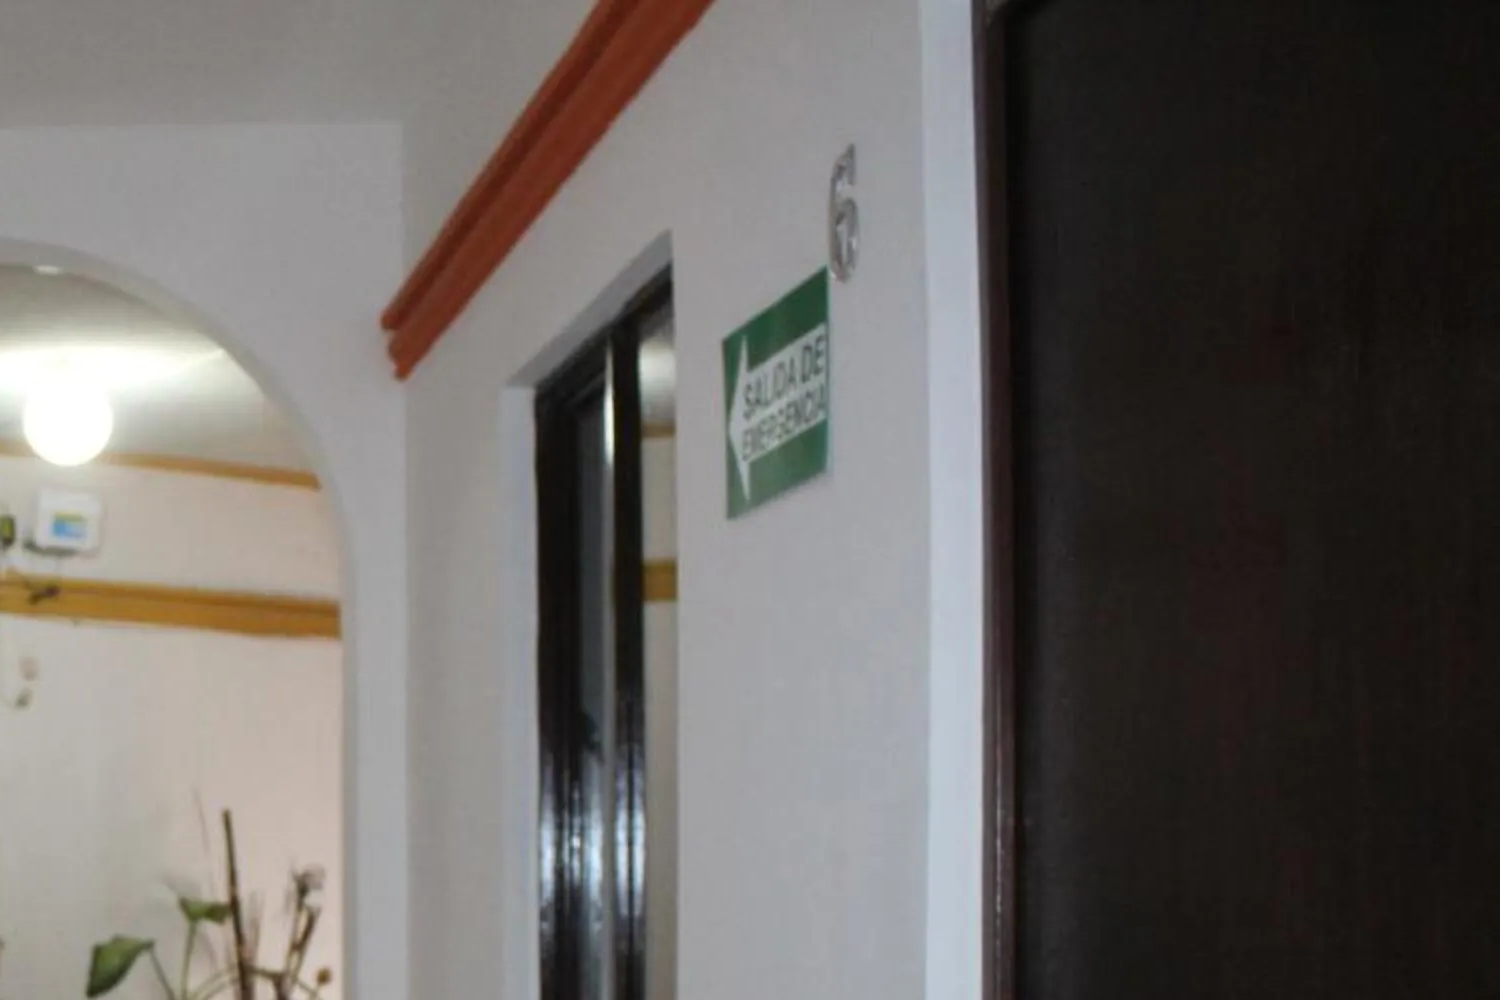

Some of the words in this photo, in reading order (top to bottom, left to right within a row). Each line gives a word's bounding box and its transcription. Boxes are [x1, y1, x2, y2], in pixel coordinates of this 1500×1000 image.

[828, 143, 860, 284] 6
[743, 357, 798, 421] SALIDA
[802, 334, 825, 384] DE
[742, 384, 826, 461] EMERGENCIA
